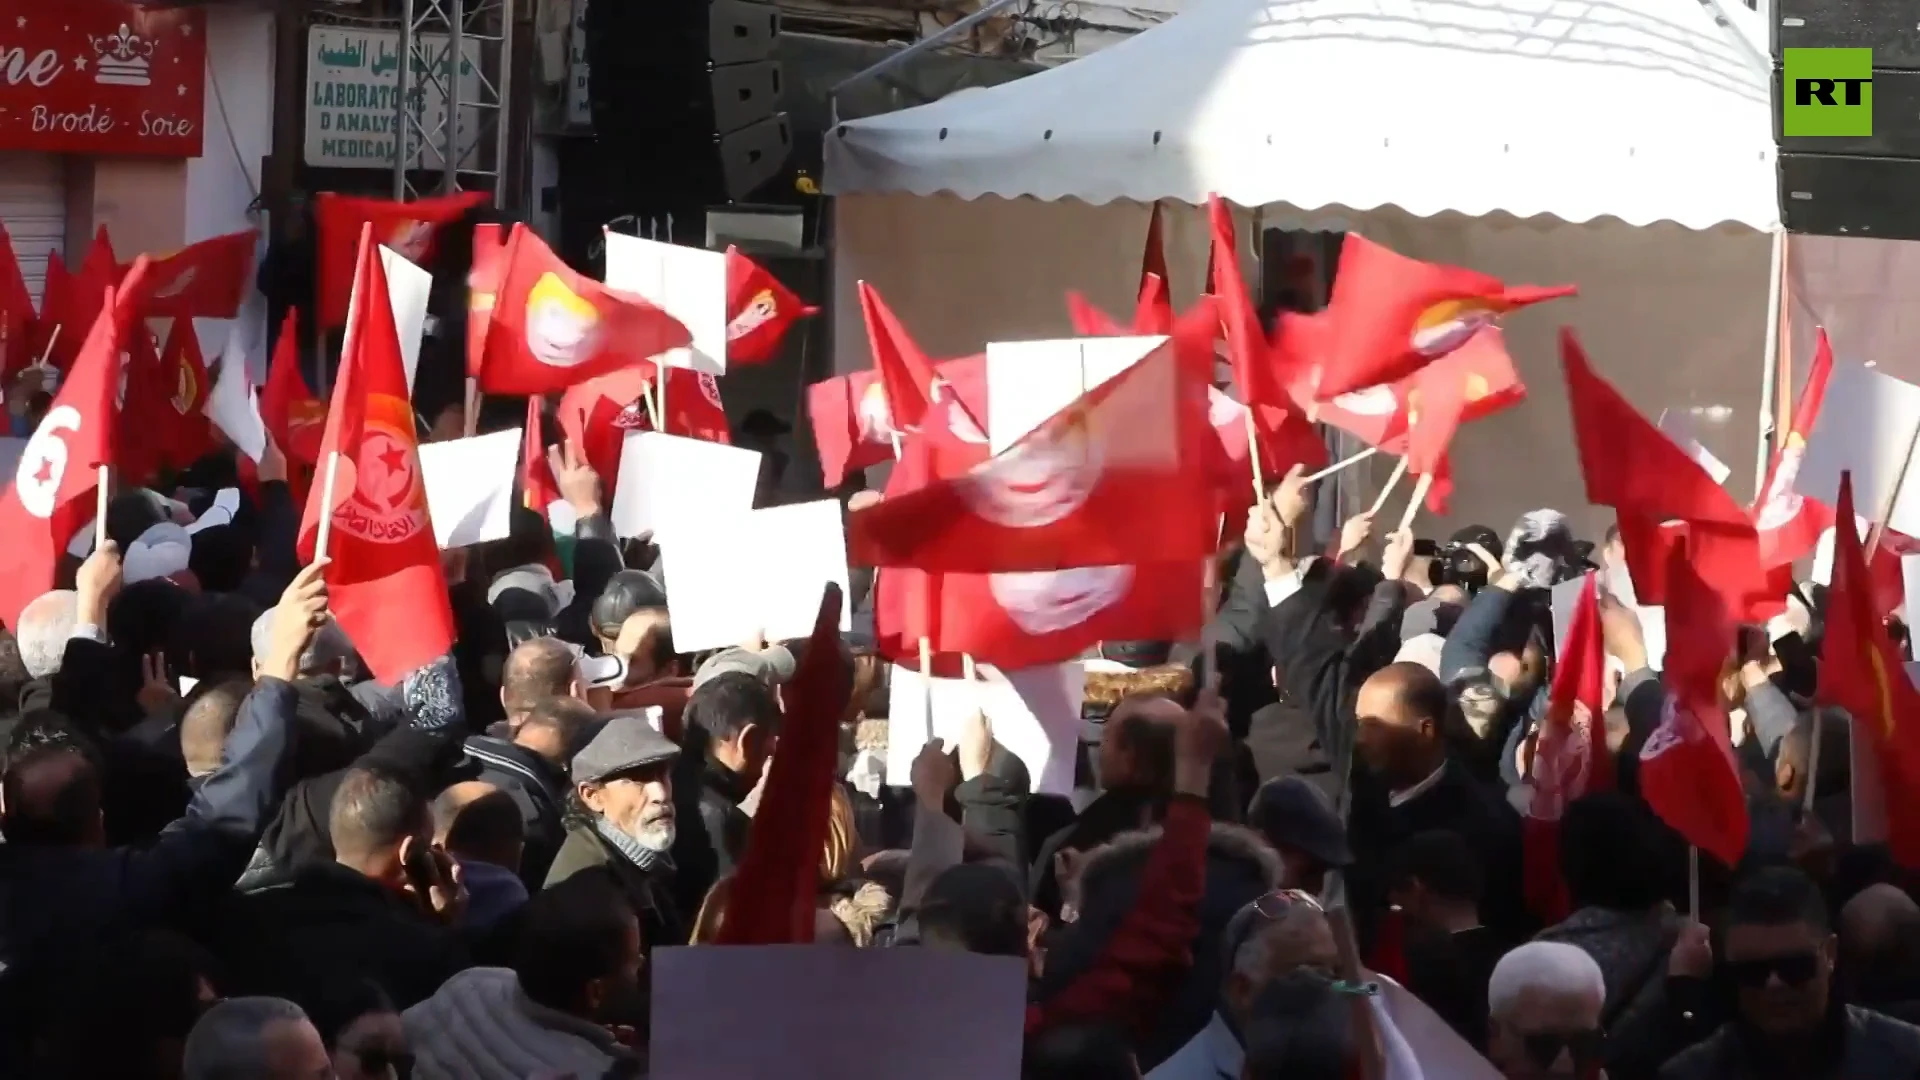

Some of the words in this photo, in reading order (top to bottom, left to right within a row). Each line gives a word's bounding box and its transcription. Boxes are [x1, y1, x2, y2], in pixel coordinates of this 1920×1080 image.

[31, 104, 114, 133] Brodé
[138, 109, 194, 136] Soie
[322, 139, 415, 162] MEDICALS
